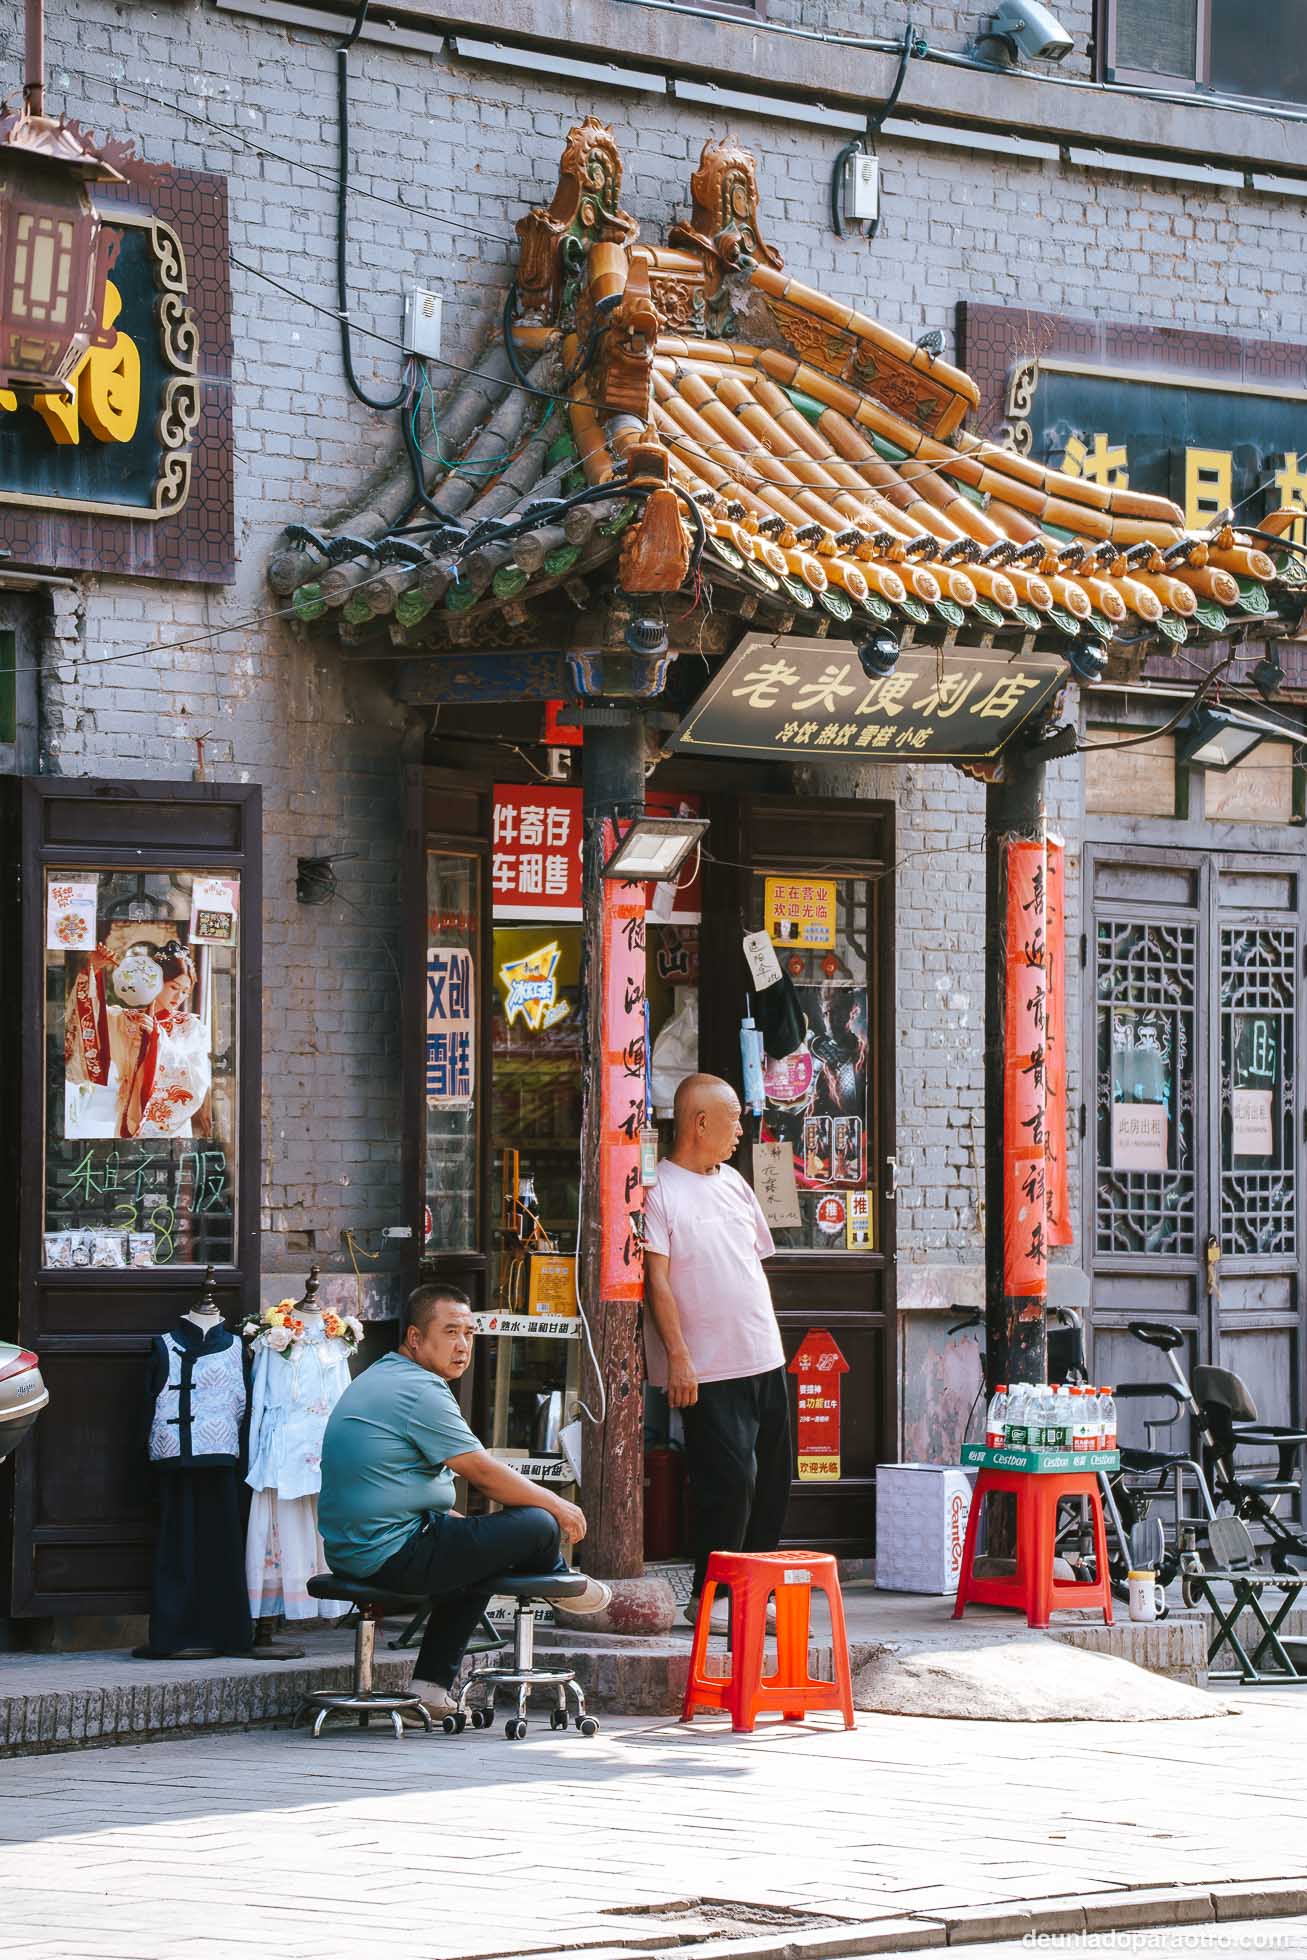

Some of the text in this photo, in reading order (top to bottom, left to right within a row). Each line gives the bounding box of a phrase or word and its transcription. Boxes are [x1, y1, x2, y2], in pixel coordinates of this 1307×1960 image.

[732, 659, 1040, 718] 老头便利店
[775, 722, 935, 749] 冷饮 热饮 雪糕 小吃
[493, 804, 570, 847] 件寄存
[493, 853, 568, 895] 车租售
[774, 885, 828, 902] 正在营业
[773, 903, 828, 919] 欢迎光临
[427, 954, 470, 1019] 文创
[427, 1032, 470, 1097] 雪糕
[1234, 1103, 1268, 1121] 此房出租
[1119, 1118, 1161, 1136] 此房出租
[62, 1149, 226, 1214] 租衣服
[854, 1196, 867, 1215] 推
[799, 1462, 838, 1473] 欢迎光临
